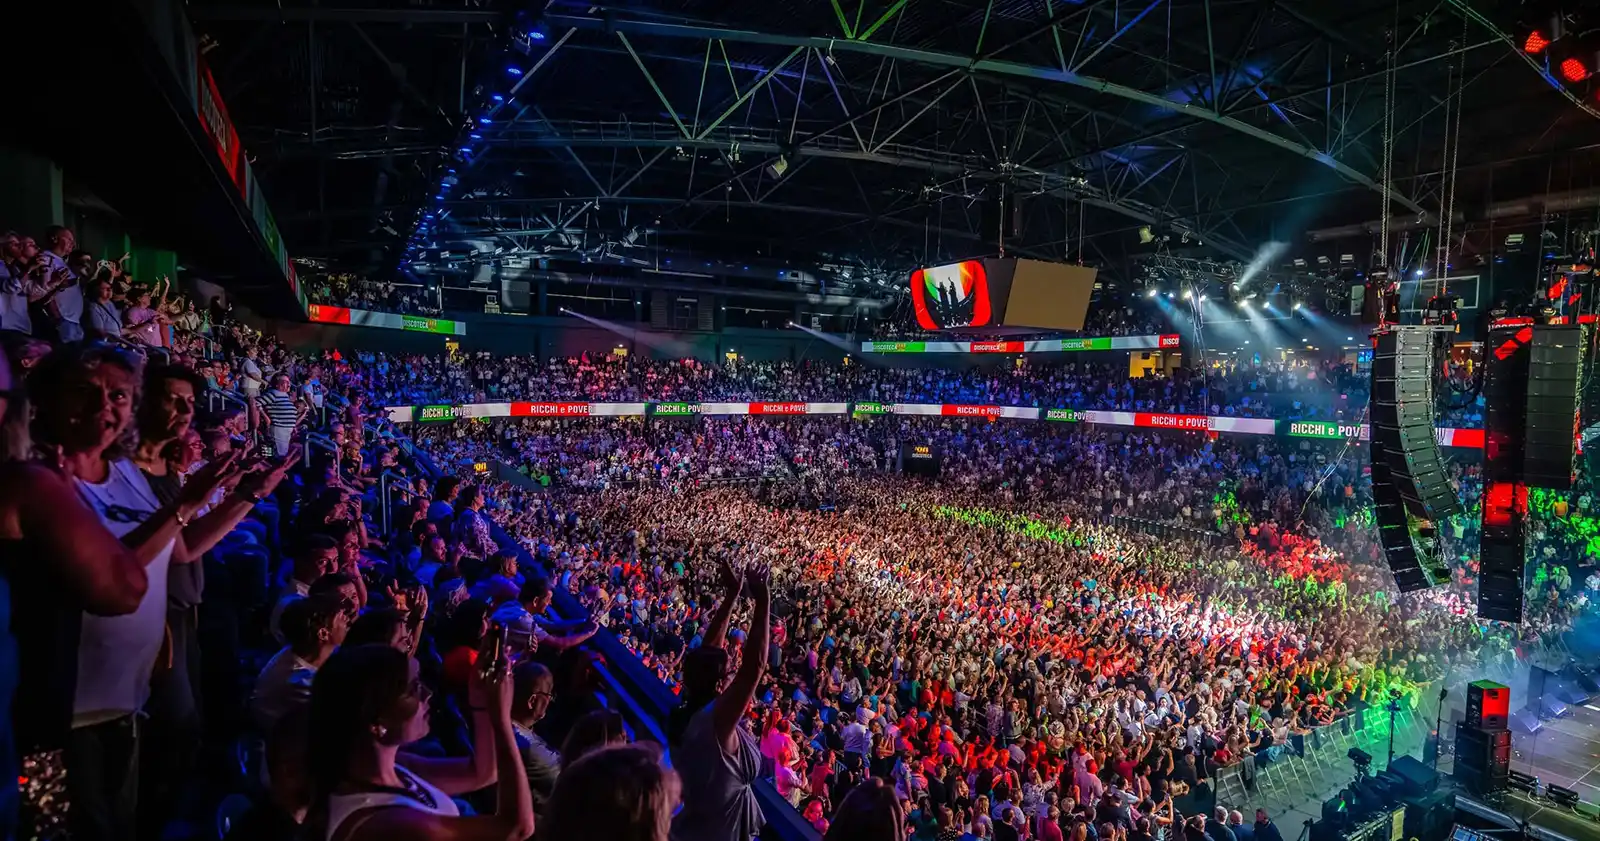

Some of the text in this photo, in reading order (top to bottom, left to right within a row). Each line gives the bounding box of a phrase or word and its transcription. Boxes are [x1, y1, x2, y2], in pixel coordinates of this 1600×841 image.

[1162, 337, 1180, 346] DISCO
[530, 405, 558, 414] RICCHI
[656, 404, 680, 413] RICCHI
[763, 404, 784, 412] RICCHI
[855, 404, 875, 412] RICCHI
[957, 406, 980, 415] RICCHI
[422, 408, 443, 419] RICCHI
[1047, 410, 1067, 419] RICCHI
[1151, 416, 1177, 426] RICCHI
[1290, 423, 1325, 435] RICCHI
[1338, 425, 1370, 438] POVE
